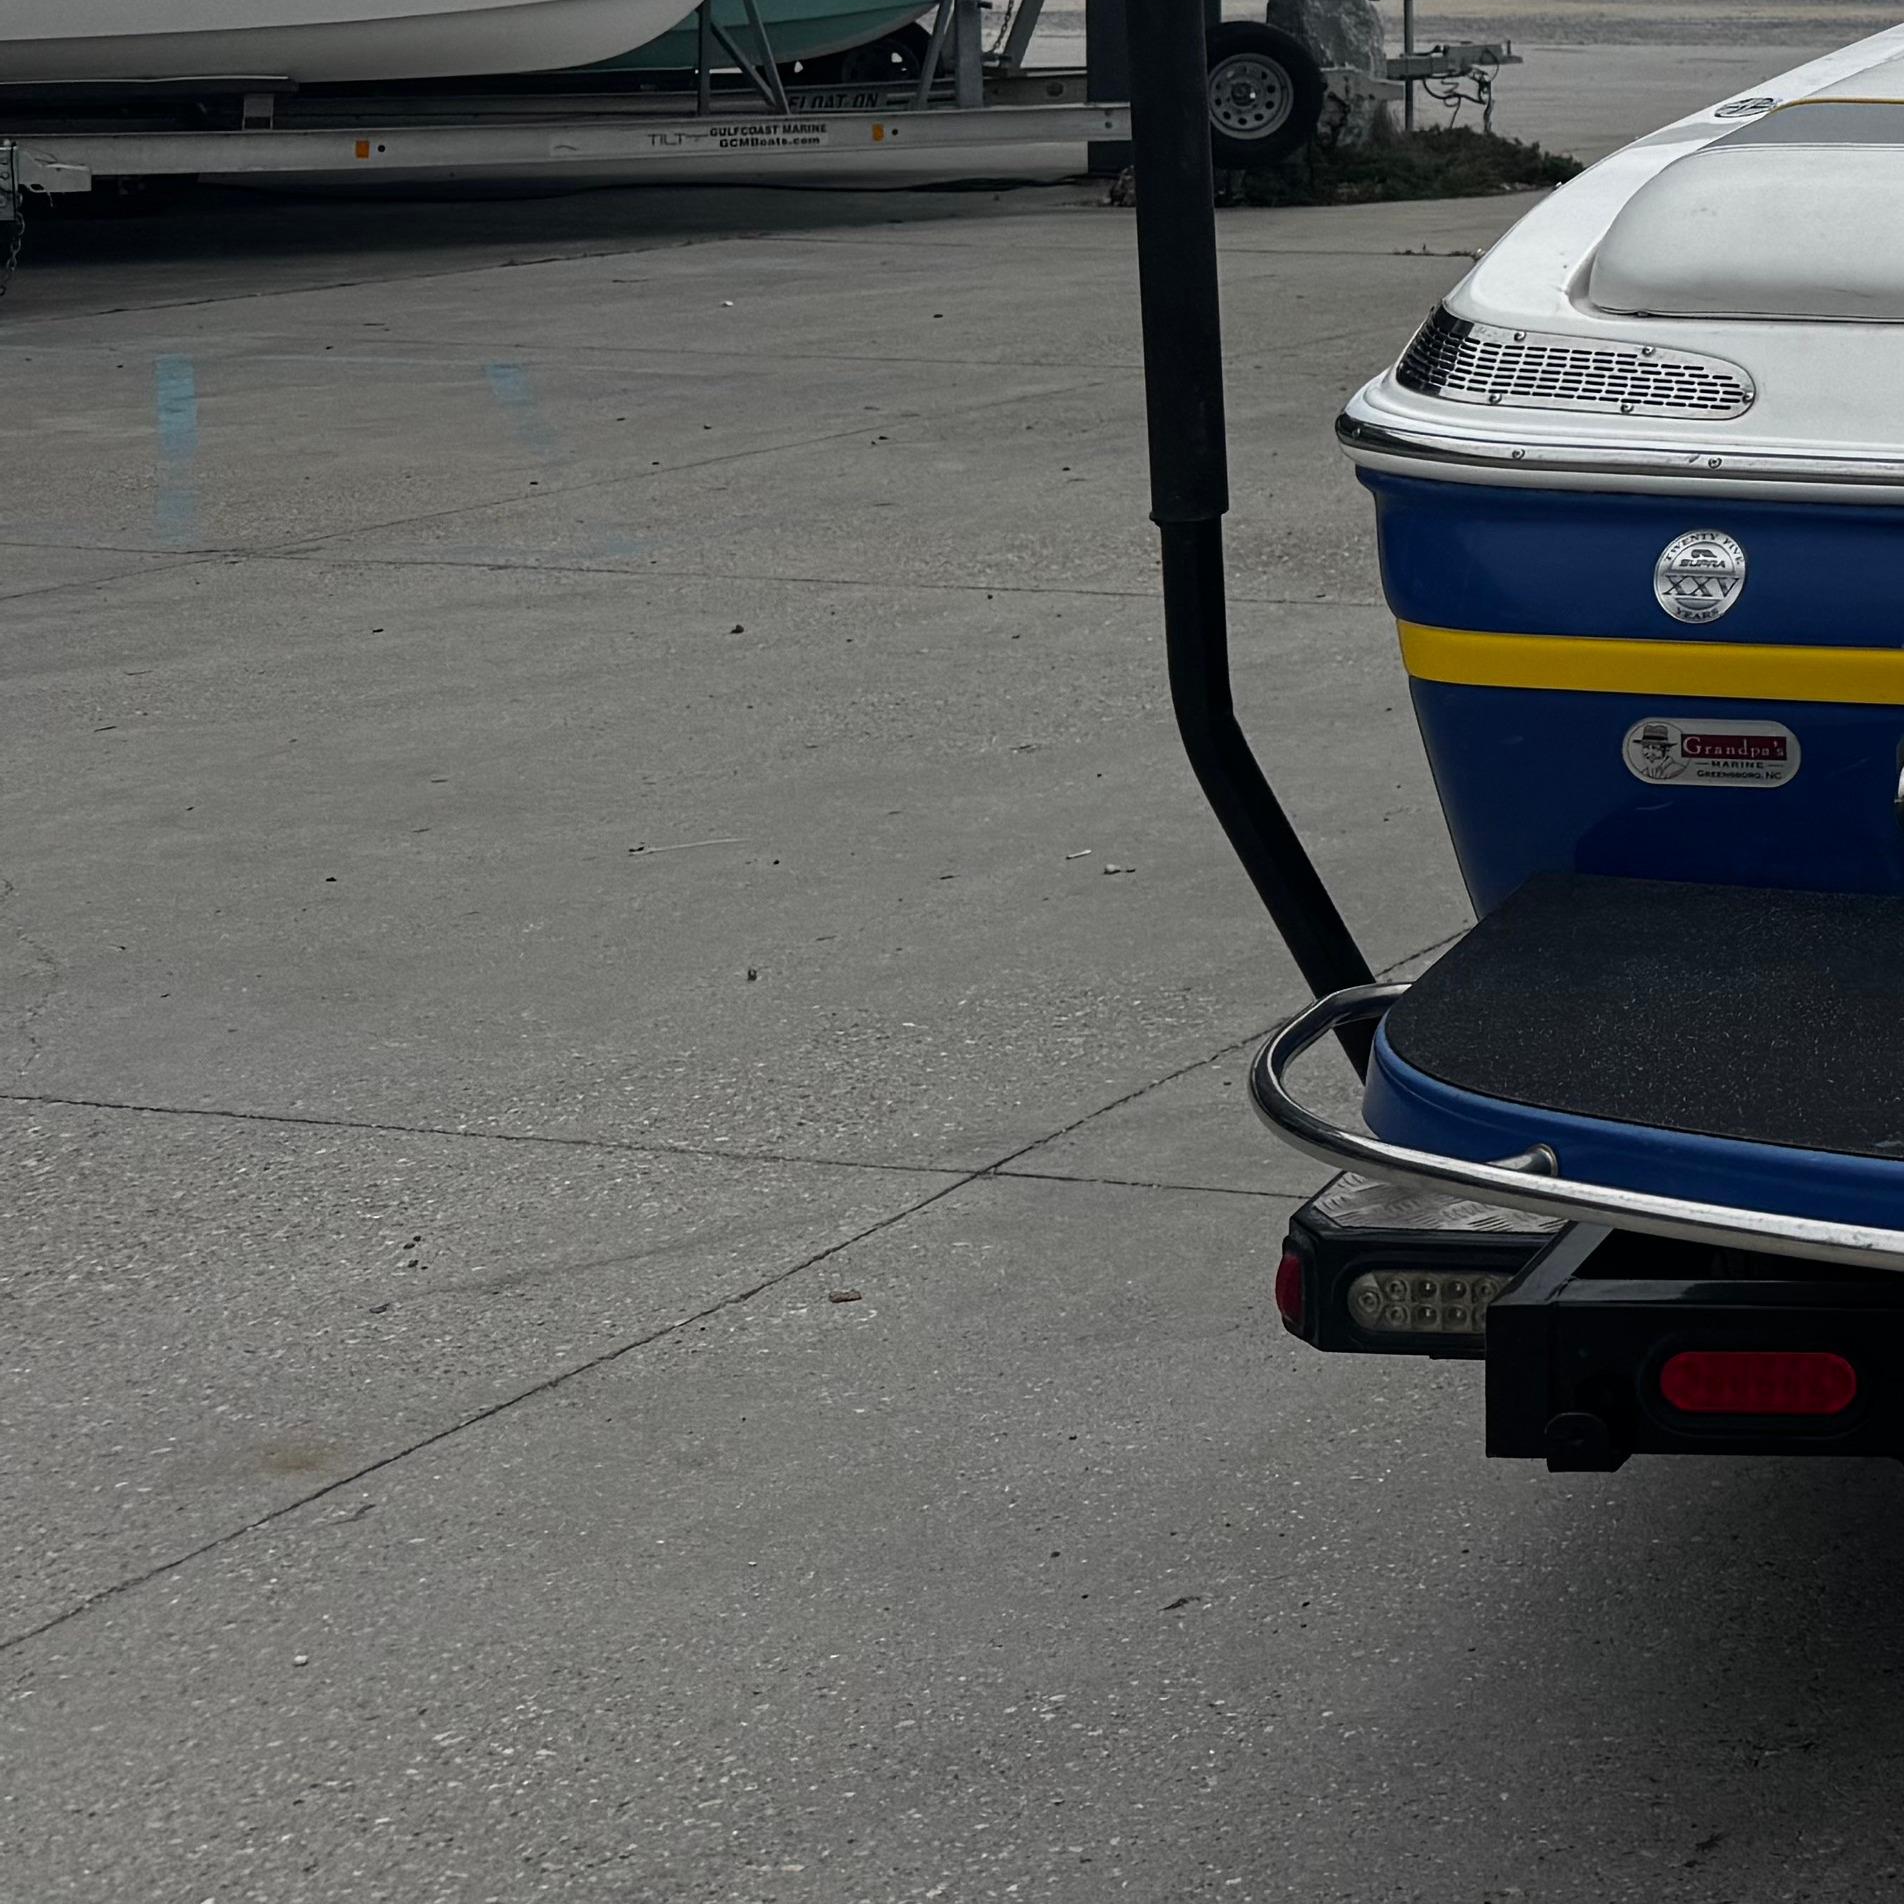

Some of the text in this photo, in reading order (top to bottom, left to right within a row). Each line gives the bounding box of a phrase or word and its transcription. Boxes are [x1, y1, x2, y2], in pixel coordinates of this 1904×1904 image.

[782, 123, 827, 134] MARINE
[1664, 532, 1745, 565] TWENTY FIVE
[1678, 558, 1726, 569] SUPRA
[1663, 575, 1741, 598] XXV
[1676, 607, 1719, 620] YEARS
[1683, 736, 1785, 757] Grandpa's
[1711, 760, 1765, 769] MARINE
[1765, 771, 1782, 780] NC
